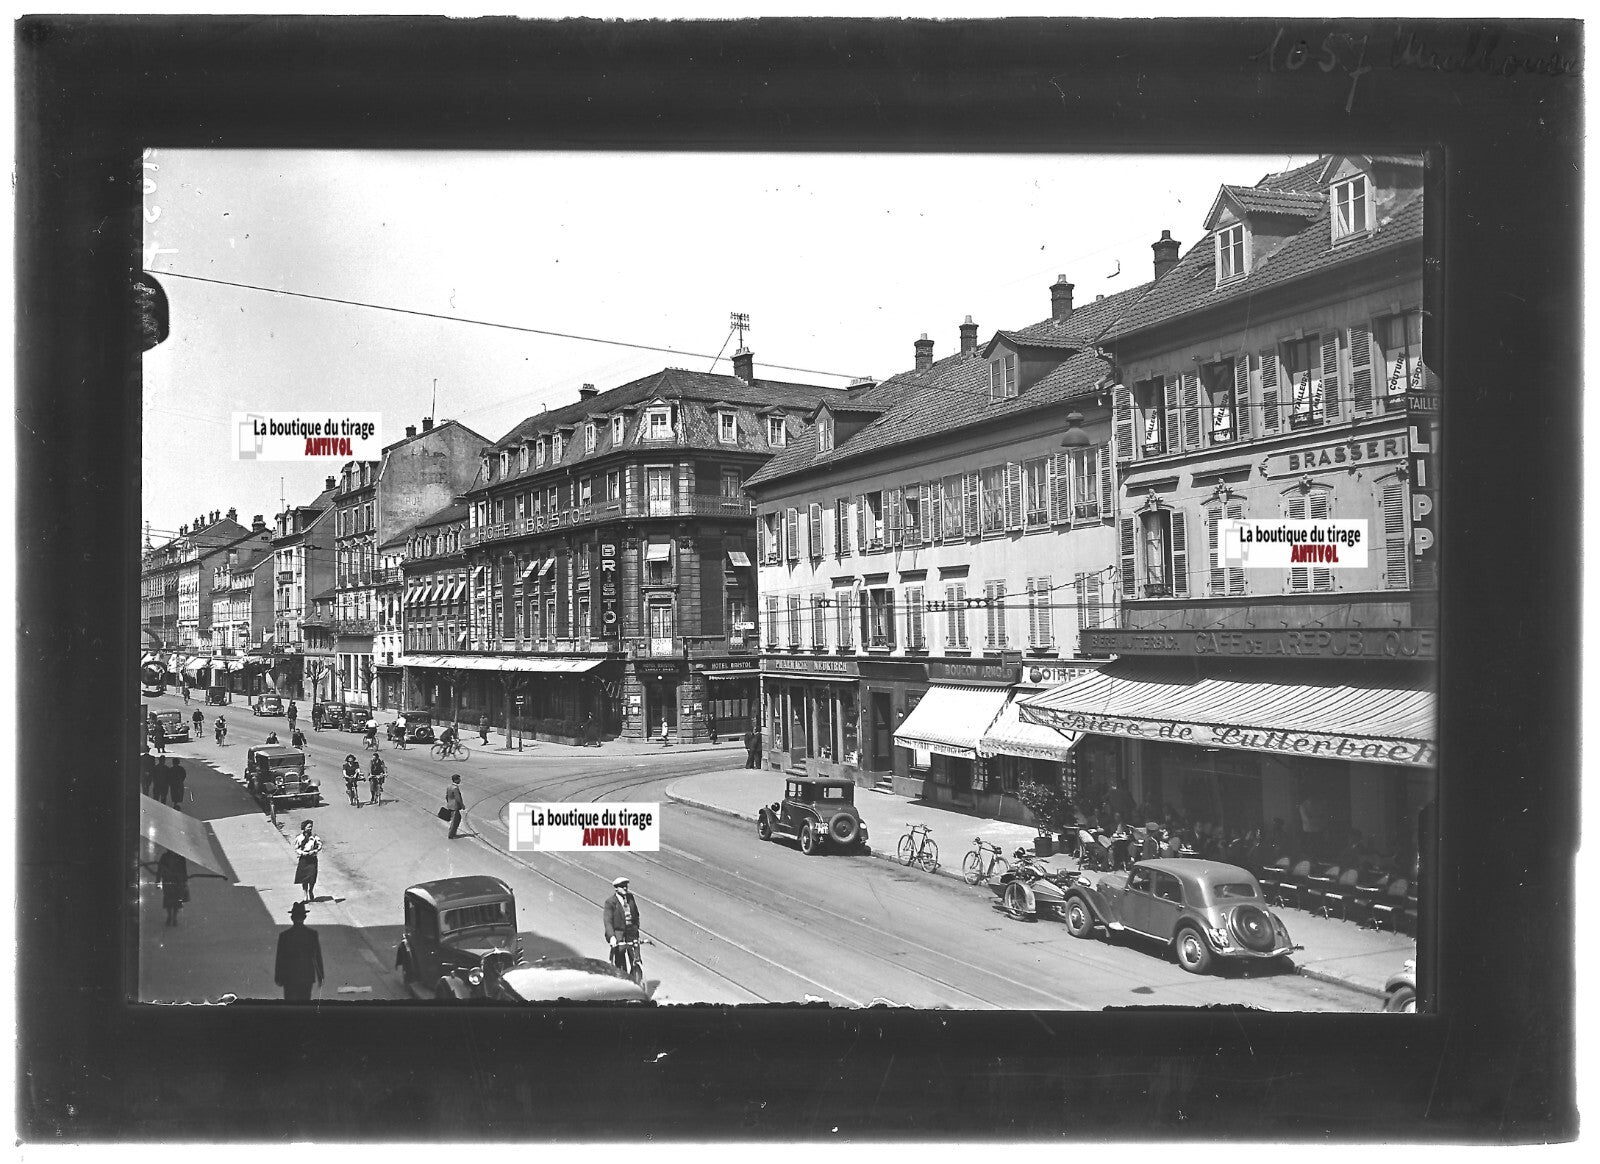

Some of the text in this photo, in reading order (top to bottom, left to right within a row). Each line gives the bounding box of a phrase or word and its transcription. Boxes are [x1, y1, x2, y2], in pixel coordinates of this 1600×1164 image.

[1249, 28, 1371, 111] 1057
[1215, 393, 1229, 426] TAILLUR
[1288, 437, 1407, 471] BRASSERI
[478, 508, 592, 542] HOTEL BRISTOL
[601, 543, 617, 636] BRISTOL
[1158, 722, 1194, 741] de
[1211, 726, 1434, 763] Lutterbach
